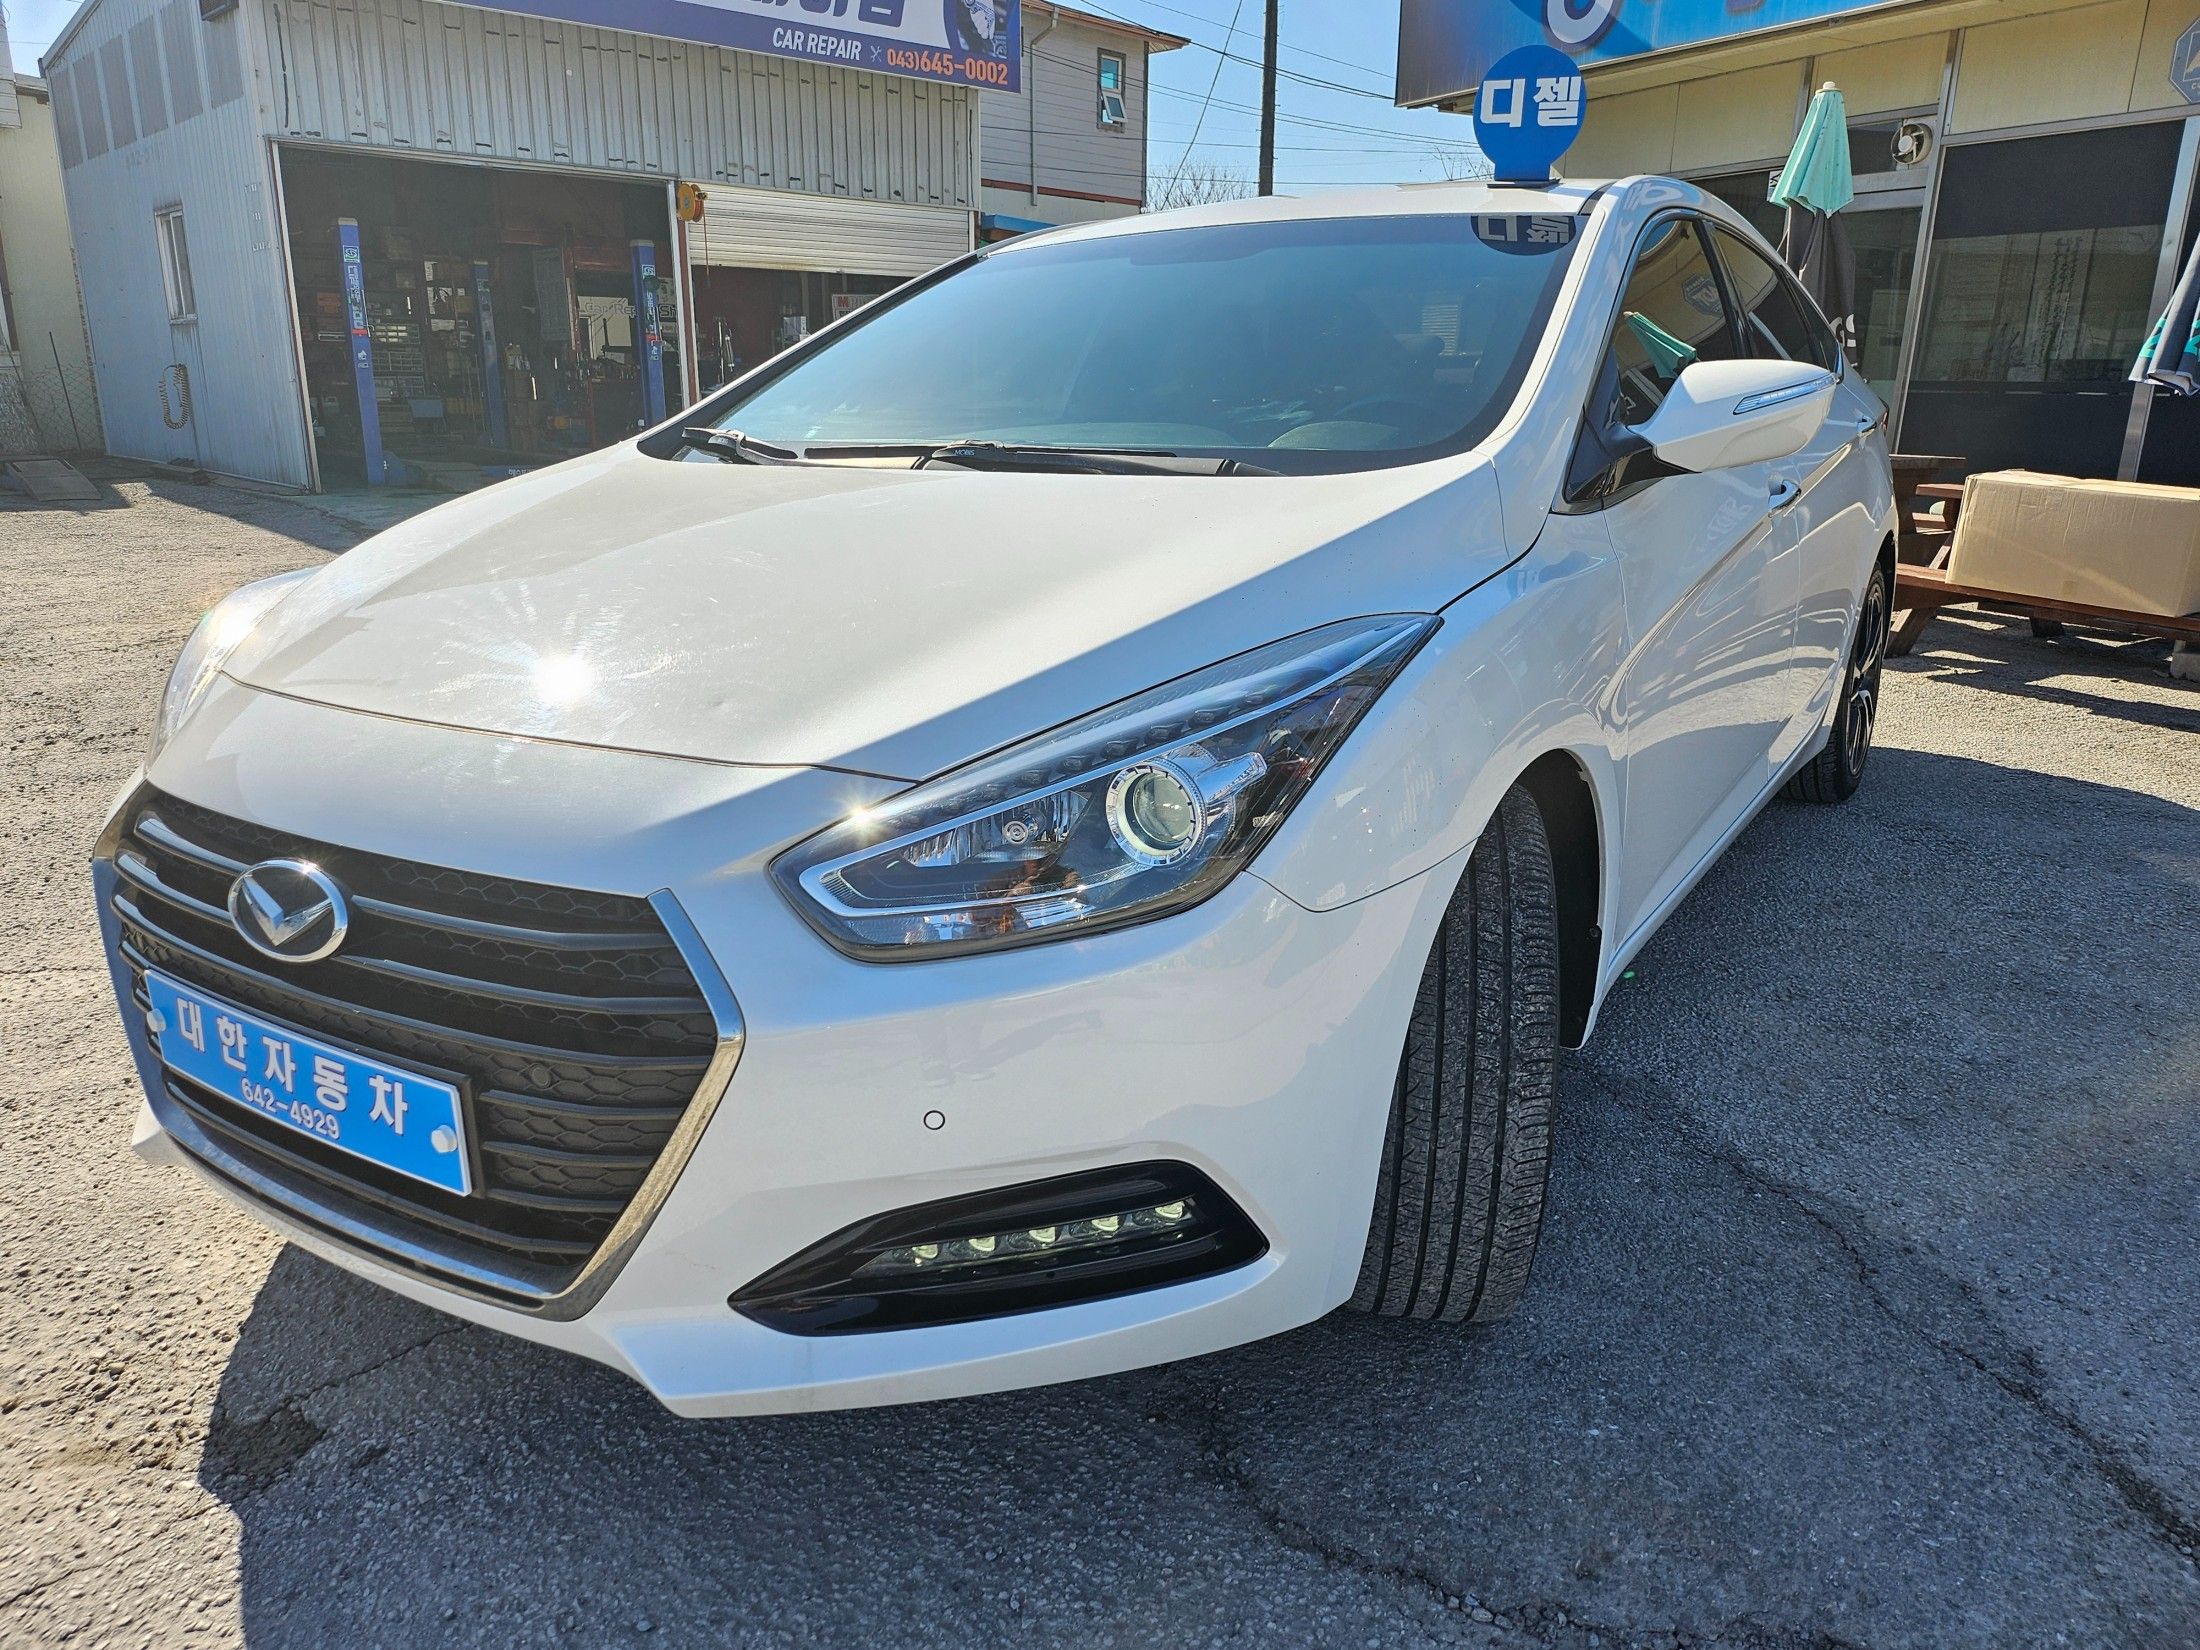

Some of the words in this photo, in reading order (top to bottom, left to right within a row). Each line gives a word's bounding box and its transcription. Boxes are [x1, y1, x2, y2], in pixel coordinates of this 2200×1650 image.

[772, 27, 804, 52] CAR
[807, 32, 862, 61] REPAIR
[886, 47, 1009, 85] 043)645-0002
[1480, 76, 1582, 127] 디젤
[176, 997, 409, 1136] 대한자동차
[240, 1076, 341, 1140] 642-4929
